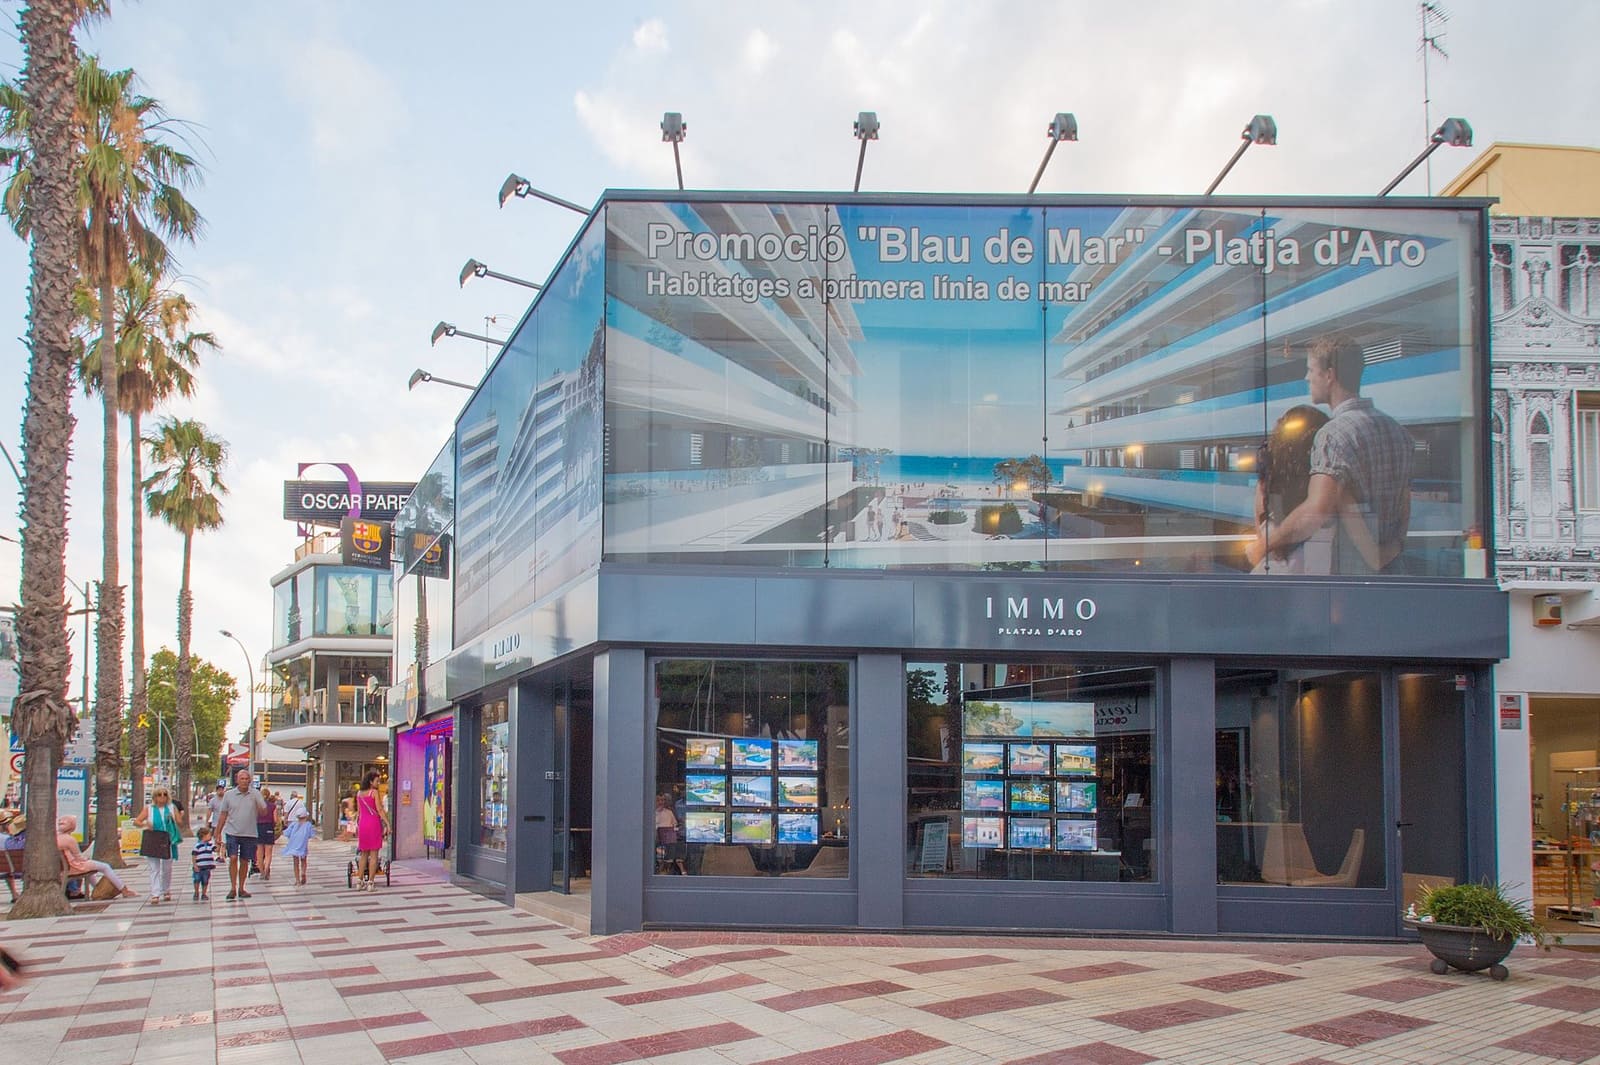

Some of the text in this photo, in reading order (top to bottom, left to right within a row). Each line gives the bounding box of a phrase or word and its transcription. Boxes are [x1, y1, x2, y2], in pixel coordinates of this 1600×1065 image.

[647, 223, 846, 263] Promoció
[857, 226, 971, 265] "Blau
[984, 226, 1034, 265] de
[1047, 228, 1145, 266] Mar"
[1185, 228, 1300, 274] Platja
[1314, 229, 1426, 267] d'Aro
[646, 271, 1092, 305] Habitatges a primera línia de mar
[301, 493, 361, 511] OSCAR
[985, 597, 1097, 620] IMMO
[998, 627, 1083, 637] PLATJA D'ARO
[493, 632, 521, 659] IMMO
